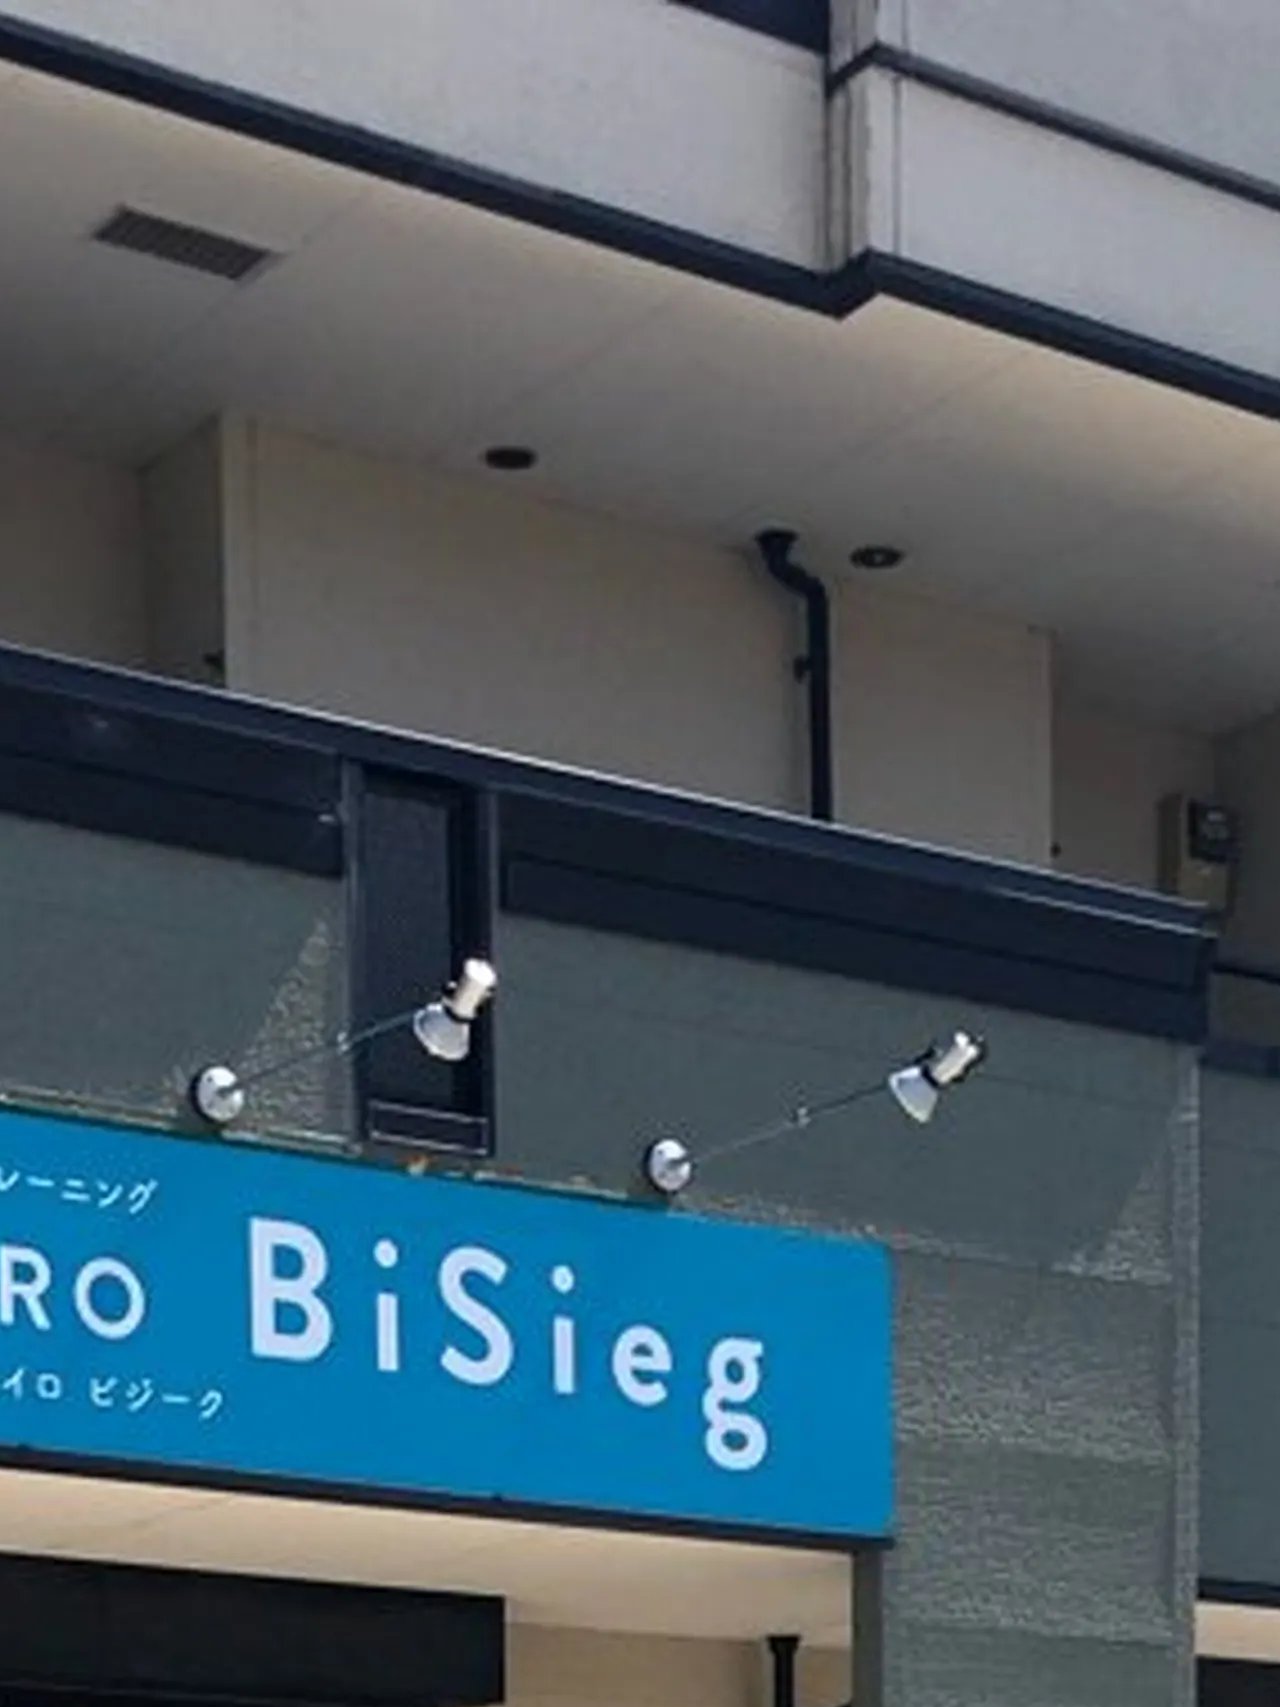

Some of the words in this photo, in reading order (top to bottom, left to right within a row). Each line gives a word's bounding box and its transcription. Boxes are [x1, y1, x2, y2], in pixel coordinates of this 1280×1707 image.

[89, 1376, 225, 1420] ビジーク
[248, 1217, 769, 1471] BiSieg
